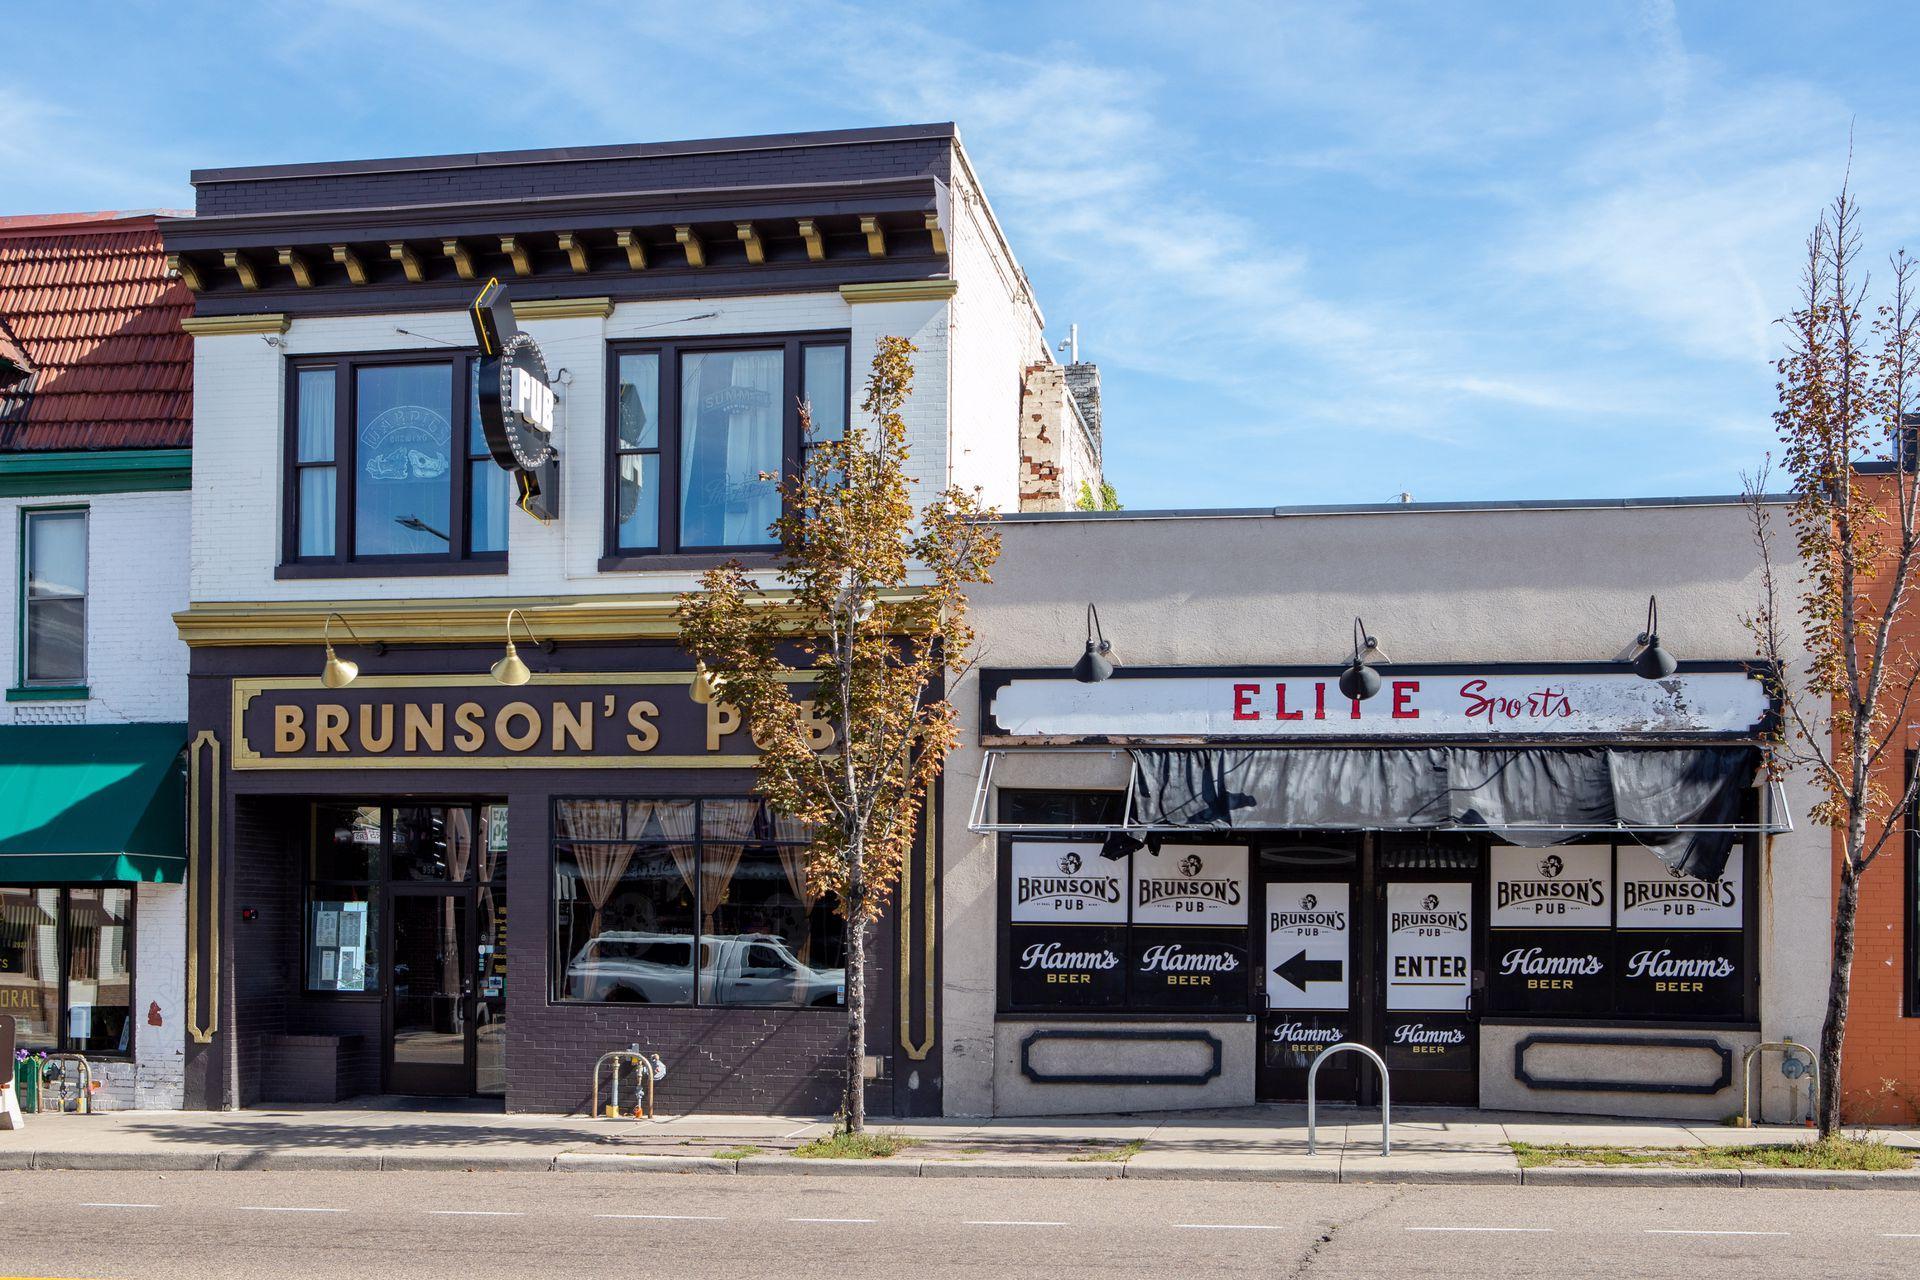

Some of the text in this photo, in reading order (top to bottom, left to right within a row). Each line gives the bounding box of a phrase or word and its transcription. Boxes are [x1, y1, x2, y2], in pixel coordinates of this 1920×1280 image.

[511, 367, 554, 433] PUB
[1459, 679, 1581, 725] Sports
[274, 694, 836, 753] BRUNSON'S PB
[1018, 876, 1121, 905] BRUNSON'S
[1139, 878, 1241, 908] BRUNSON'S
[1498, 878, 1605, 911] BRUNSON'S
[1624, 878, 1736, 912] BRUNSON'S
[1055, 900, 1083, 910] PUB
[1175, 902, 1204, 912] PUB
[1535, 903, 1566, 914] PUB
[1663, 904, 1696, 915] PUB
[1271, 910, 1345, 933] BRUNSON'S
[1297, 928, 1319, 936] PUB
[1392, 910, 1468, 934] BRUNSON'S
[1419, 929, 1440, 937] PUB
[1019, 942, 1119, 970] Hamm's
[1140, 944, 1239, 971] Hamm's
[1394, 956, 1467, 978] ENTER
[1499, 947, 1604, 975] Hamm's
[1626, 949, 1735, 978] Hamm's
[1047, 974, 1091, 983] BEER
[1167, 975, 1211, 985] BEER
[1528, 979, 1574, 989] BEER
[1655, 982, 1703, 992] BEER
[1272, 1022, 1344, 1042] Hamm's
[1393, 1023, 1466, 1044] Hamm's
[1291, 1044, 1323, 1052] BEER
